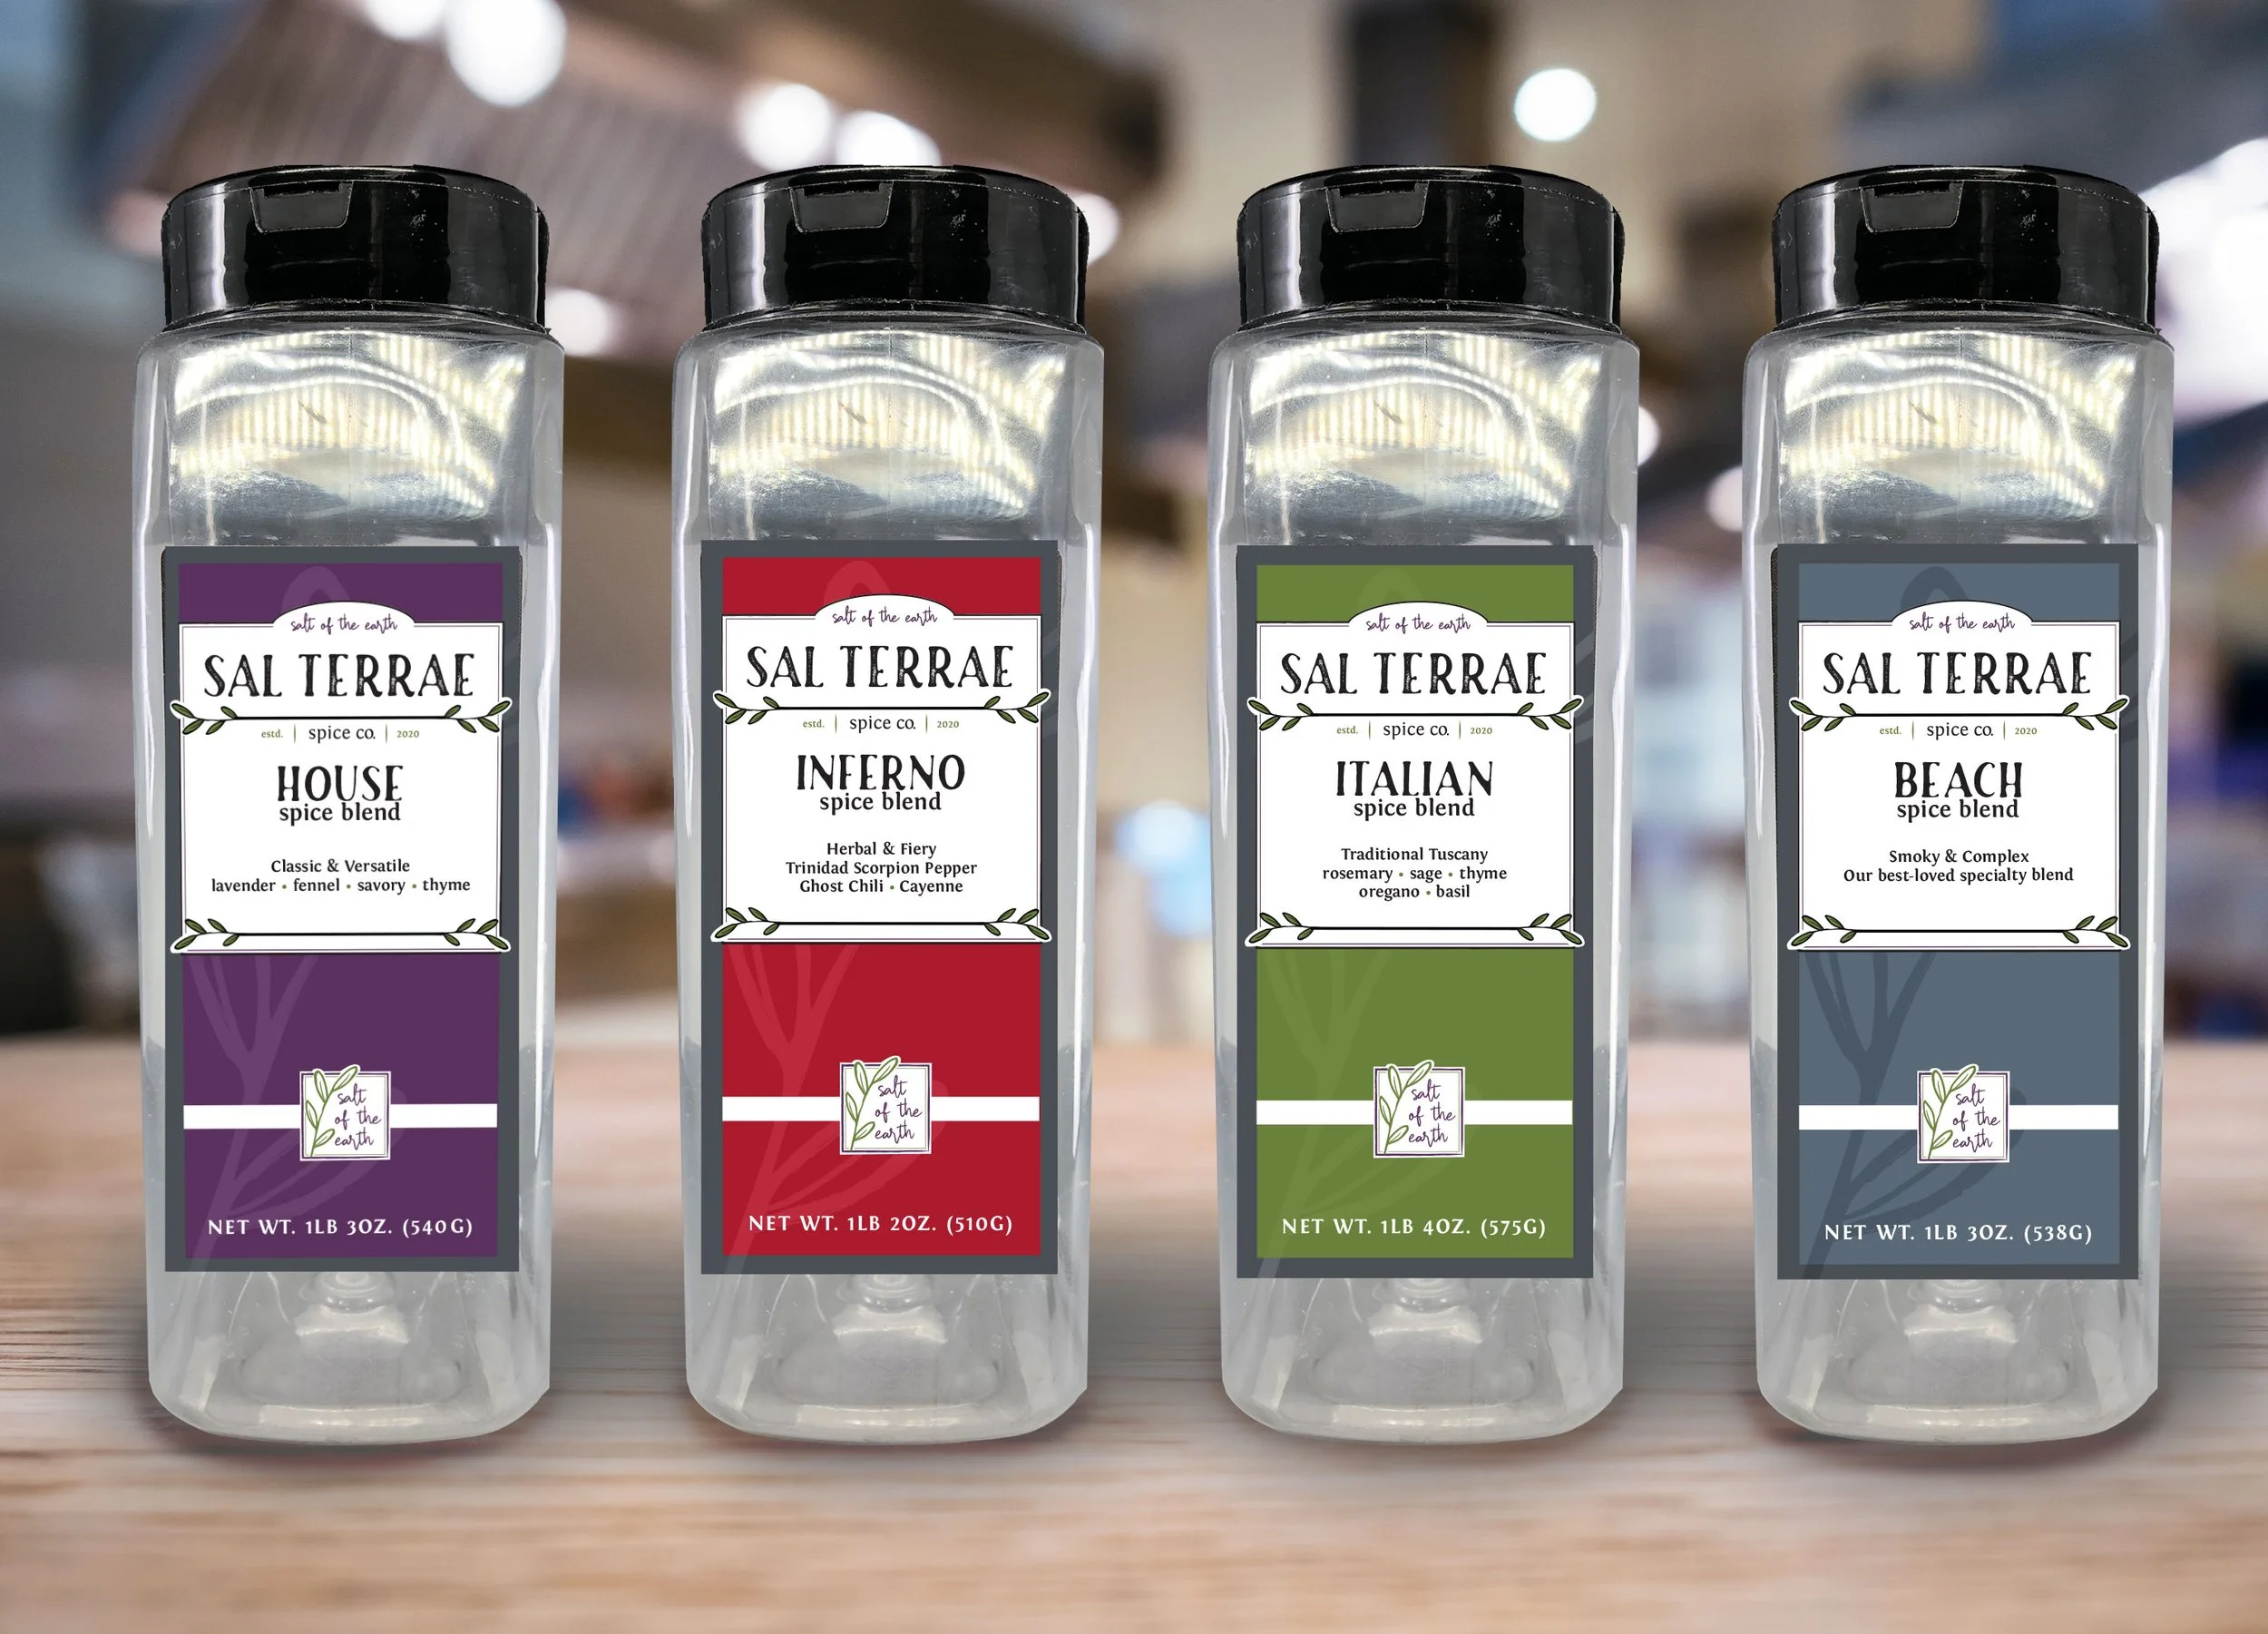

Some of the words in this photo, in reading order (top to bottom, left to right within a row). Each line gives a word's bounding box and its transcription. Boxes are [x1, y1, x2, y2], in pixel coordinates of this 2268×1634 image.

[291, 612, 315, 632] salt
[321, 617, 333, 635] of
[337, 614, 359, 630] the
[365, 613, 397, 633] earth
[833, 605, 856, 624] salt
[862, 610, 875, 627] of
[878, 606, 900, 622] the
[905, 606, 937, 626] earth
[1366, 612, 1390, 631] salt
[1395, 617, 1408, 634] of
[1412, 614, 1433, 630] the
[1439, 613, 1471, 633] earth
[1910, 612, 1933, 631] salt
[1940, 616, 1951, 633] of
[1956, 612, 1978, 629] the
[1983, 612, 2015, 632] earth
[204, 654, 282, 697] SAL
[298, 653, 474, 697] TERRAE
[747, 646, 824, 688] SAL
[840, 646, 1013, 689] TERRAE
[1281, 653, 1357, 694] SAL
[1374, 652, 1546, 695] TERRAE
[1823, 652, 1901, 694] SAL
[1917, 652, 2091, 695] TERRAE
[261, 729, 283, 738] estd.
[309, 726, 350, 744] spice
[357, 729, 376, 739] co.
[803, 719, 824, 728] estd.
[850, 716, 891, 733] spice
[897, 719, 915, 729] co.
[1337, 726, 1358, 734] estd.
[1383, 722, 1424, 739] spice
[1431, 726, 1449, 736] co.
[1880, 726, 1901, 734] estd.
[1927, 722, 1968, 740] spice
[1974, 726, 1993, 736] co.
[278, 765, 403, 801] HOUSE
[797, 754, 964, 790] INFERNO
[1336, 761, 1492, 796] ITALIAN
[1895, 762, 2022, 797] BEACH
[279, 803, 333, 827] spice
[341, 802, 401, 820] blend
[820, 793, 874, 816] spice
[882, 791, 942, 810] blend
[1354, 798, 1407, 821] spice
[1415, 797, 1475, 816] blend
[1898, 800, 1950, 823] spice
[1960, 799, 2019, 817] blend
[827, 842, 875, 855] Herbal
[884, 842, 894, 855] &
[901, 843, 936, 859] Fiery
[1341, 847, 1422, 860] Traditional
[1429, 848, 1488, 865] Tuscany
[1890, 849, 1940, 866] Smoky
[1945, 849, 1957, 863] &
[1962, 849, 2028, 866] Complex
[271, 859, 321, 872] Classic
[327, 858, 339, 872] &
[345, 858, 409, 872] Versatile
[786, 861, 848, 874] Trinidad
[855, 862, 919, 877] Scorpion
[925, 862, 977, 877] Pepper
[1324, 870, 1393, 883] rosemary
[1411, 870, 1442, 883] sage
[1460, 866, 1507, 884] thyme
[1844, 869, 1872, 882] Our
[1879, 868, 1955, 882] best-loved
[1960, 867, 2027, 885] specialty
[2032, 867, 2074, 881] blend
[212, 878, 276, 892] lavender
[294, 878, 339, 891] fennel
[357, 882, 406, 895] savory
[423, 877, 470, 895] thyme
[800, 879, 844, 892] Ghost
[849, 879, 883, 892] Chili
[900, 880, 963, 896] Cayenne
[1359, 888, 1420, 901] oregano
[1436, 885, 1470, 897] basil
[337, 1083, 367, 1106] salt
[877, 1075, 908, 1099] salt
[1411, 1079, 1442, 1101] salt
[1955, 1083, 1986, 1107] salt
[335, 1110, 349, 1129] of
[357, 1106, 381, 1124] the
[875, 1102, 890, 1122] of
[897, 1098, 922, 1117] the
[1409, 1106, 1423, 1126] of
[1431, 1101, 1455, 1120] the
[1953, 1111, 1968, 1131] of
[1975, 1107, 2000, 1126] the
[335, 1127, 374, 1150] earth
[875, 1120, 914, 1144] earth
[1409, 1123, 1448, 1147] earth
[1953, 1129, 1992, 1152] earth
[209, 1220, 249, 1234] NET
[259, 1219, 295, 1234] WT.
[306, 1219, 337, 1234] 1LB
[347, 1219, 391, 1235] 3OZ.
[749, 1216, 790, 1230] NET
[800, 1216, 837, 1230] WT.
[848, 1216, 879, 1230] 1LB
[891, 1216, 935, 1230] 2OZ.
[947, 1216, 1012, 1236] (510G)
[1283, 1218, 1324, 1233] NET
[1334, 1218, 1371, 1234] WT.
[1382, 1219, 1413, 1233] 1LB
[1423, 1219, 1470, 1235] 4OZ.
[1481, 1218, 1545, 1238] (575G)
[1825, 1225, 1866, 1239] NET
[1877, 1225, 1914, 1239] WT.
[1925, 1225, 1957, 1239] 1LB
[1969, 1225, 2013, 1241] 3OZ.
[2025, 1225, 2091, 1245] (538G)
